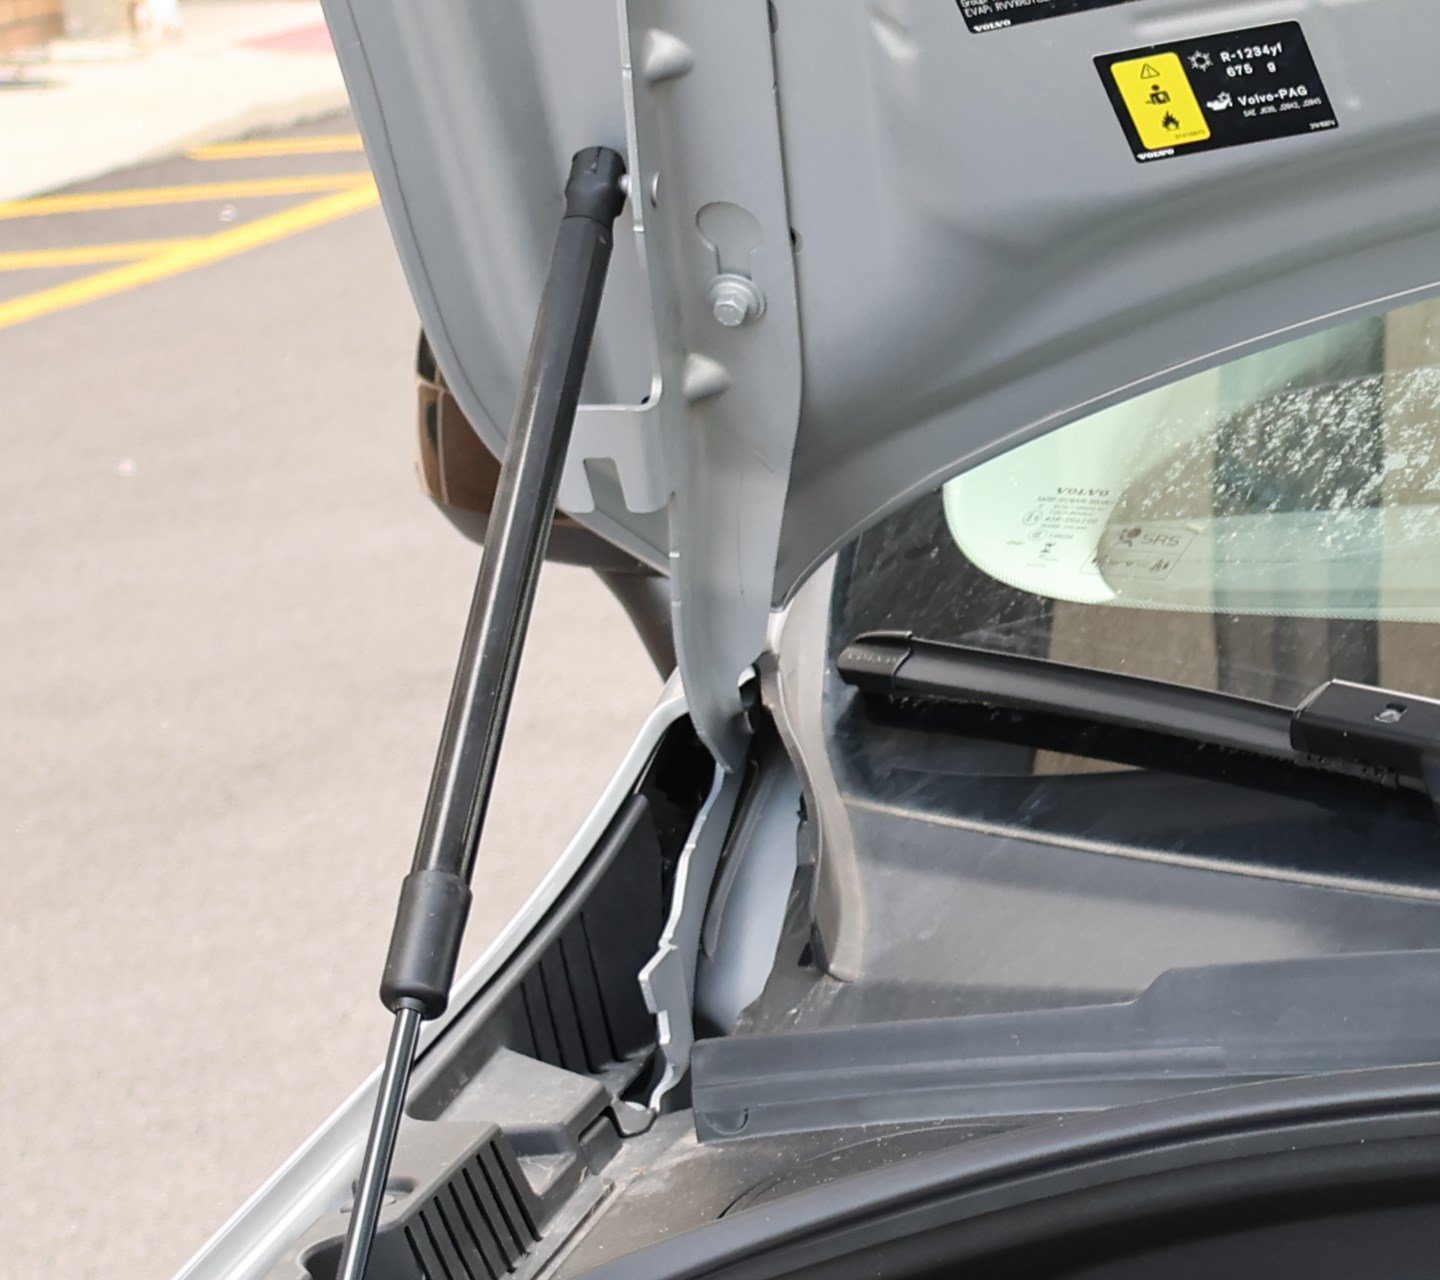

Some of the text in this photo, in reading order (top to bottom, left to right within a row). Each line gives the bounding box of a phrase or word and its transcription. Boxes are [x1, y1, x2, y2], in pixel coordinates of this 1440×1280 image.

[972, 19, 1012, 33] VOLVO
[1220, 42, 1284, 63] R-1234yf
[1226, 63, 1254, 78] 675
[1237, 84, 1309, 107] Volvo-PAG
[1137, 147, 1175, 162] VOLVO
